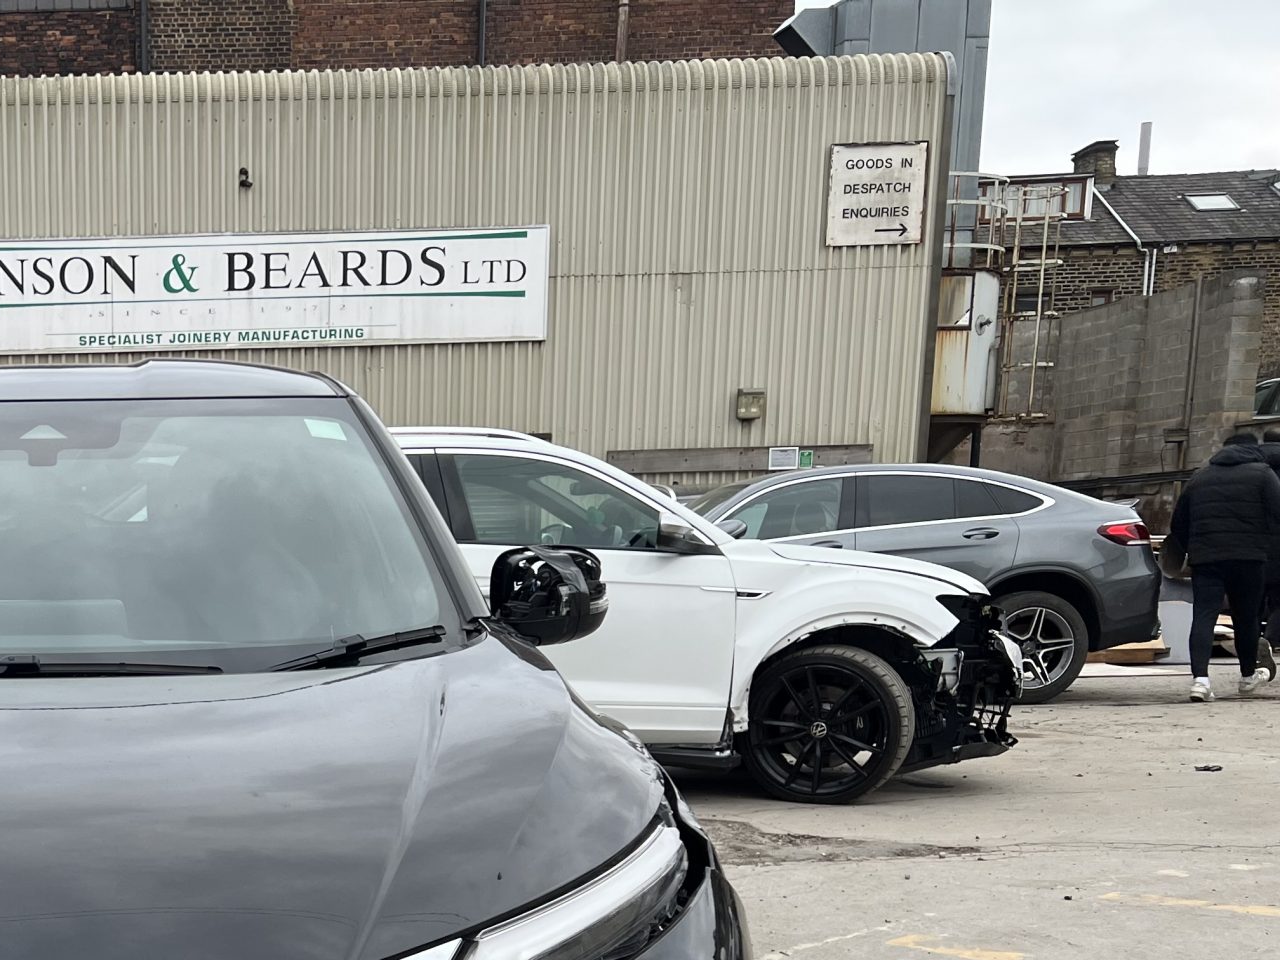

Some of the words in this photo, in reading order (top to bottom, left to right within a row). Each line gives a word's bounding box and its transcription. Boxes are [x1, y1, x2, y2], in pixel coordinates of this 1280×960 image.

[845, 158, 893, 170] GOODS
[901, 157, 913, 169] IN
[843, 182, 911, 195] DESPATCH
[842, 205, 909, 219] ENQUIRIES
[163, 253, 199, 294] &
[223, 246, 447, 292] BEARDS
[459, 259, 527, 285] LTD
[79, 333, 163, 346] SPECIALIST
[169, 331, 231, 344] JOINERY
[238, 327, 365, 342] MANUFACTURING
